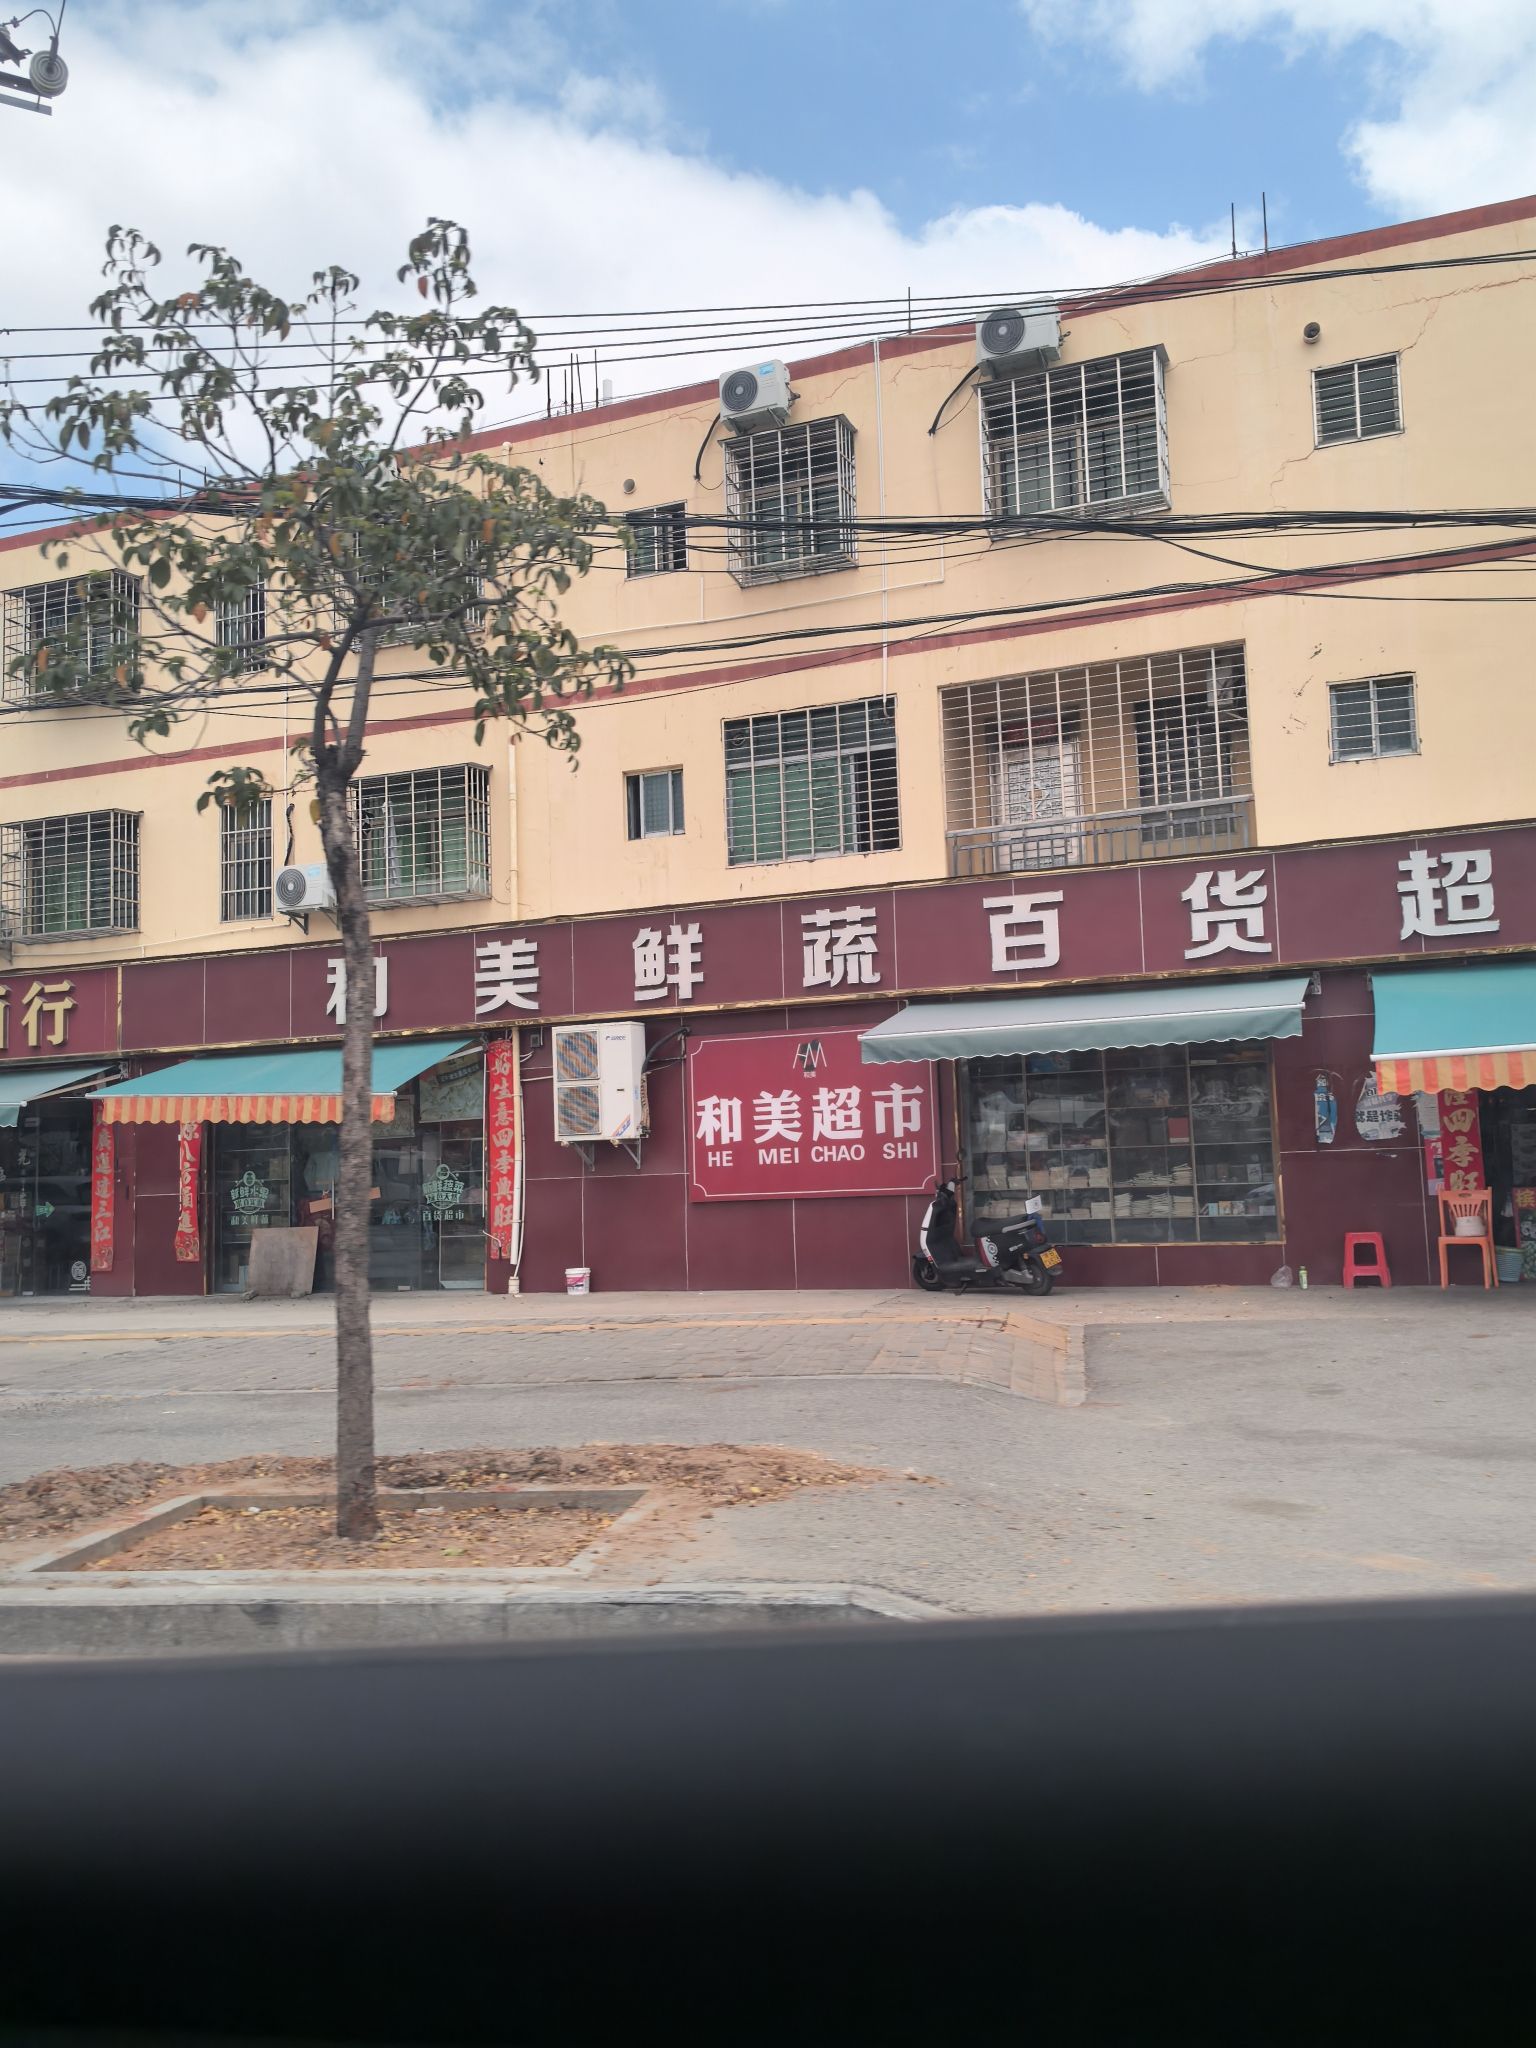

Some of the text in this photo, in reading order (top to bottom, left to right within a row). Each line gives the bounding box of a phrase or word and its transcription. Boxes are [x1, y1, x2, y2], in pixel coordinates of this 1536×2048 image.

[0, 979, 77, 1049] 行
[696, 1082, 925, 1146] 和美超市
[708, 1142, 918, 1167] HE MEI CHAO SHI
[422, 1210, 465, 1221] 百货超市
